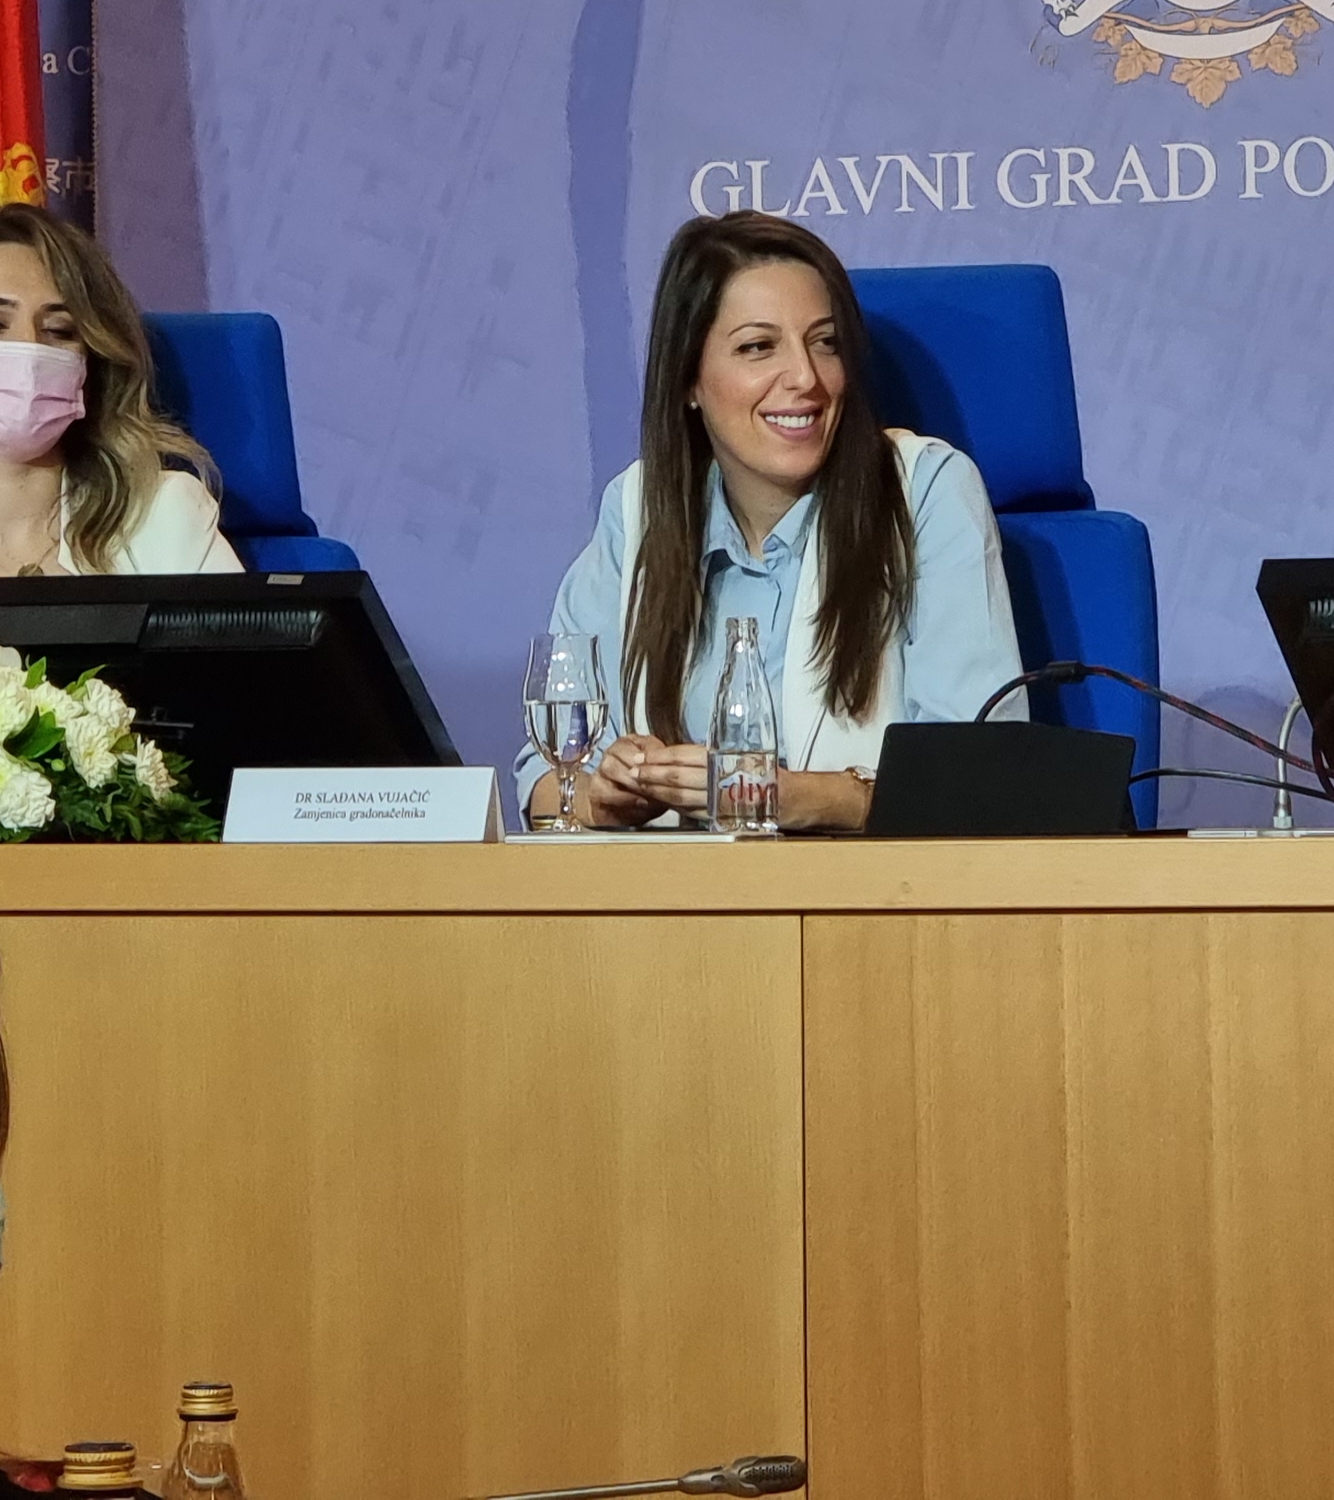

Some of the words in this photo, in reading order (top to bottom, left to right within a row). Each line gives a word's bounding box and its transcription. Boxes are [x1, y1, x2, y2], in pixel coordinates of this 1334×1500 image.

[689, 151, 976, 219] GLAVNI
[996, 141, 1217, 208] GRAD
[295, 792, 312, 804] DR
[378, 789, 430, 803] VUJAČIĆ
[293, 808, 347, 822] Zamjenica
[349, 807, 426, 821] gradonačelnika
